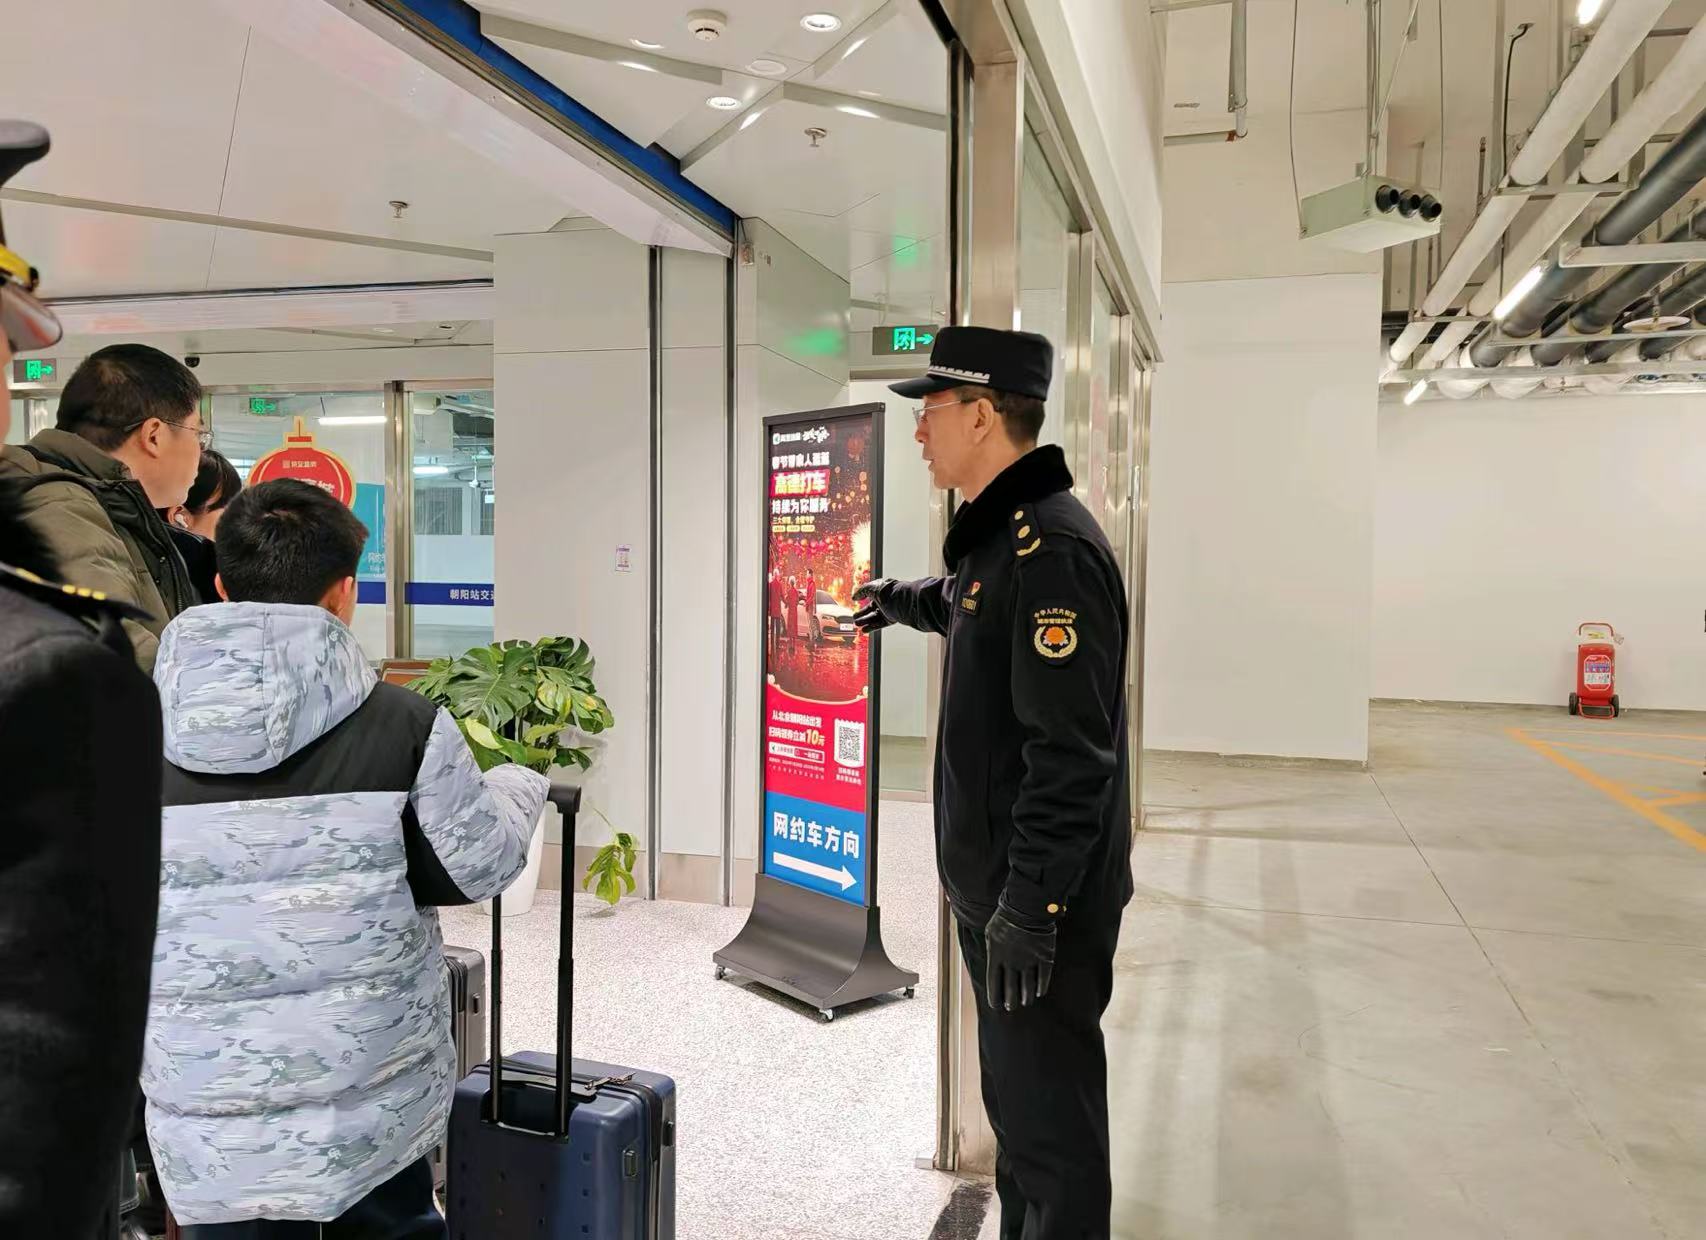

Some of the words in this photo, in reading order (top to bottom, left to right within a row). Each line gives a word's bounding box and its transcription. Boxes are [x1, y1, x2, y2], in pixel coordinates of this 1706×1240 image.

[773, 811, 860, 859] 网约车方向
